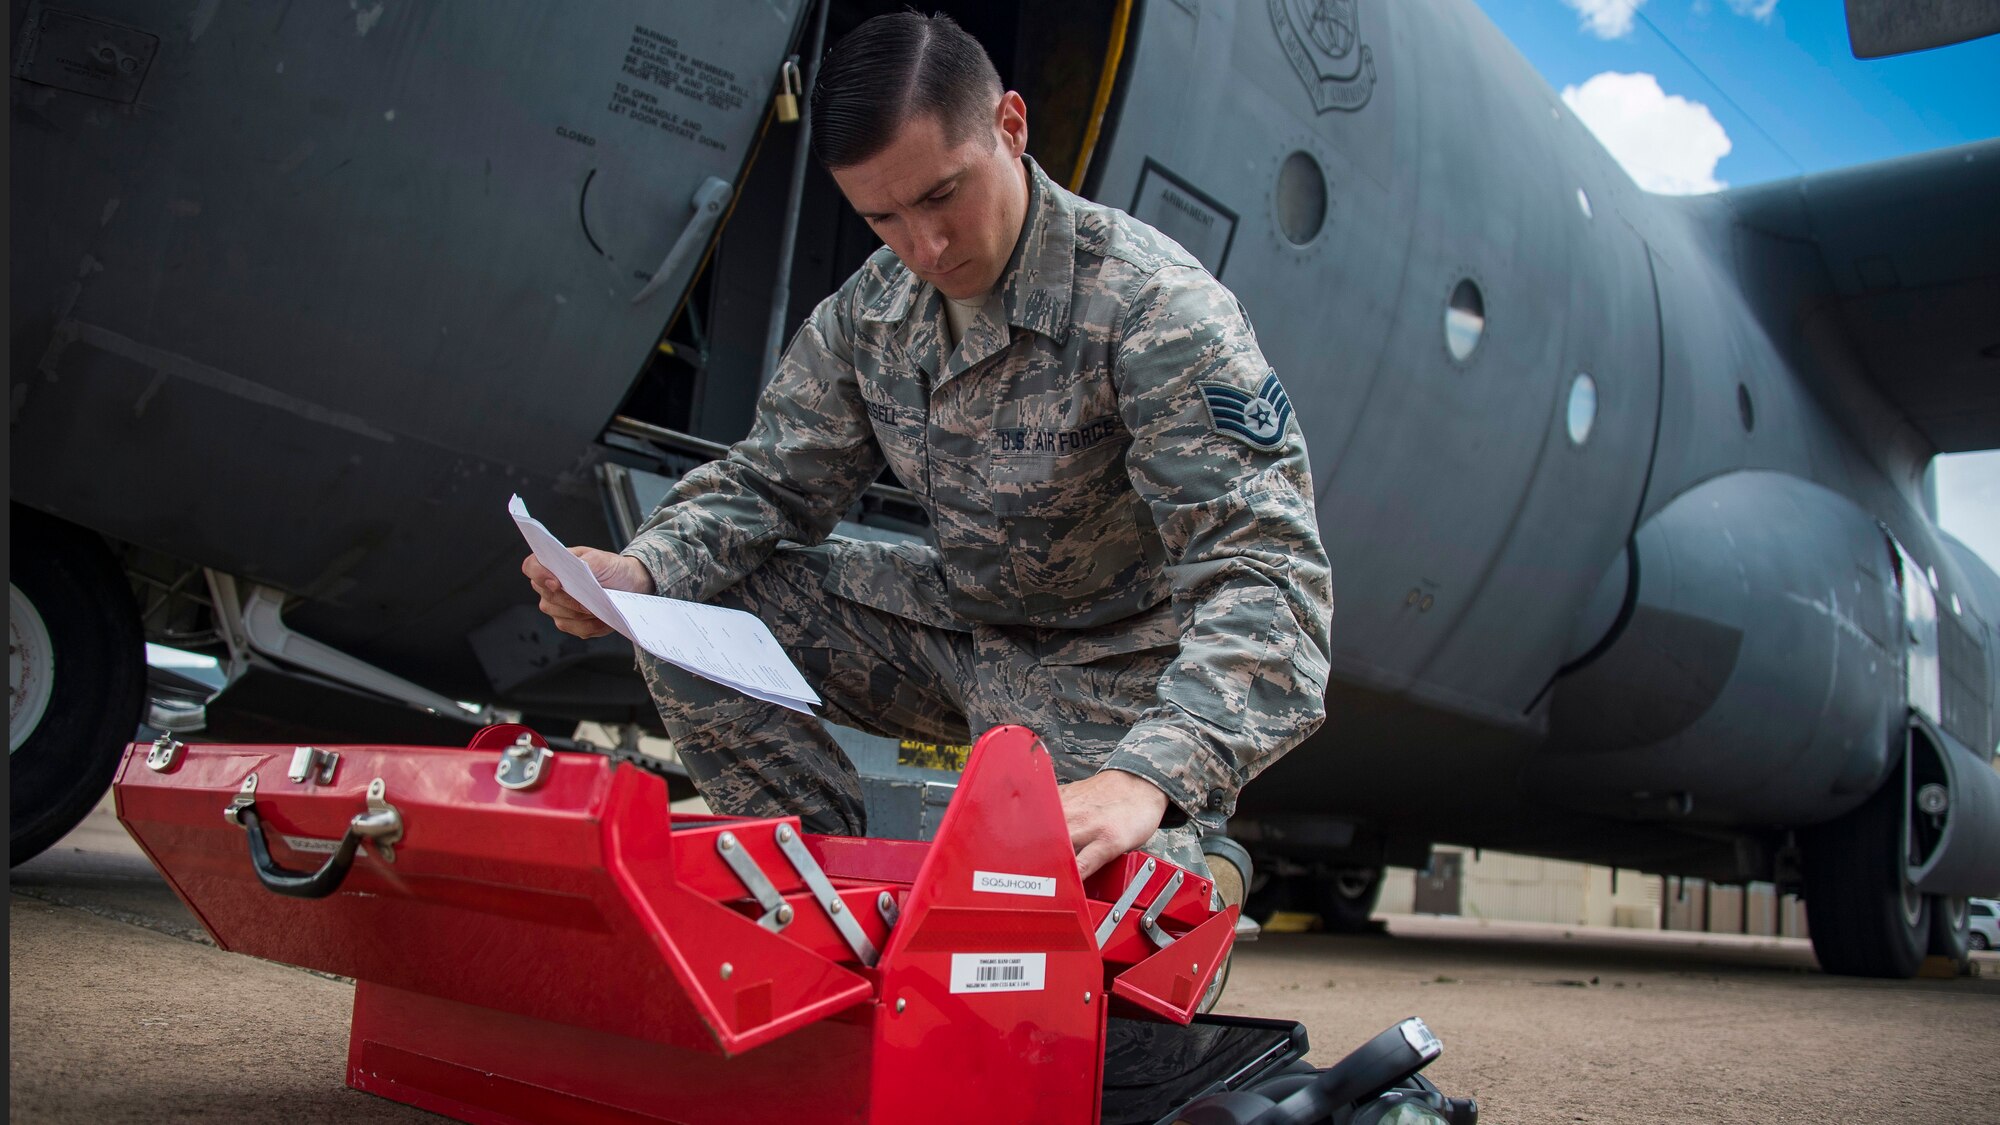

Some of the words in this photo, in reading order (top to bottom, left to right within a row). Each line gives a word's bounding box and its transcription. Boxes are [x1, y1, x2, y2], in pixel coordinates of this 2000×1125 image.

[635, 25, 679, 48] WARNING
[632, 35, 657, 50] WITH
[660, 45, 688, 62] CREW
[691, 58, 736, 81] MEMBERS
[683, 78, 703, 90] AND
[698, 71, 726, 88] DOOR
[616, 82, 629, 94] TO
[632, 88, 659, 105] OPEN
[613, 92, 638, 108] TURN
[640, 103, 679, 122] HANDLE
[682, 118, 703, 131] AND
[555, 126, 596, 147] CLOSED
[607, 102, 627, 115] LET
[629, 110, 658, 126] DOOR
[660, 120, 695, 140] ROTATE
[698, 134, 728, 152] DOWN
[1161, 189, 1215, 228] ARMAMENT
[1001, 431, 1030, 451] U.S.
[1035, 431, 1057, 451] AIR
[1058, 420, 1114, 451] FORCE
[981, 877, 1042, 890] SQ5JHC001
